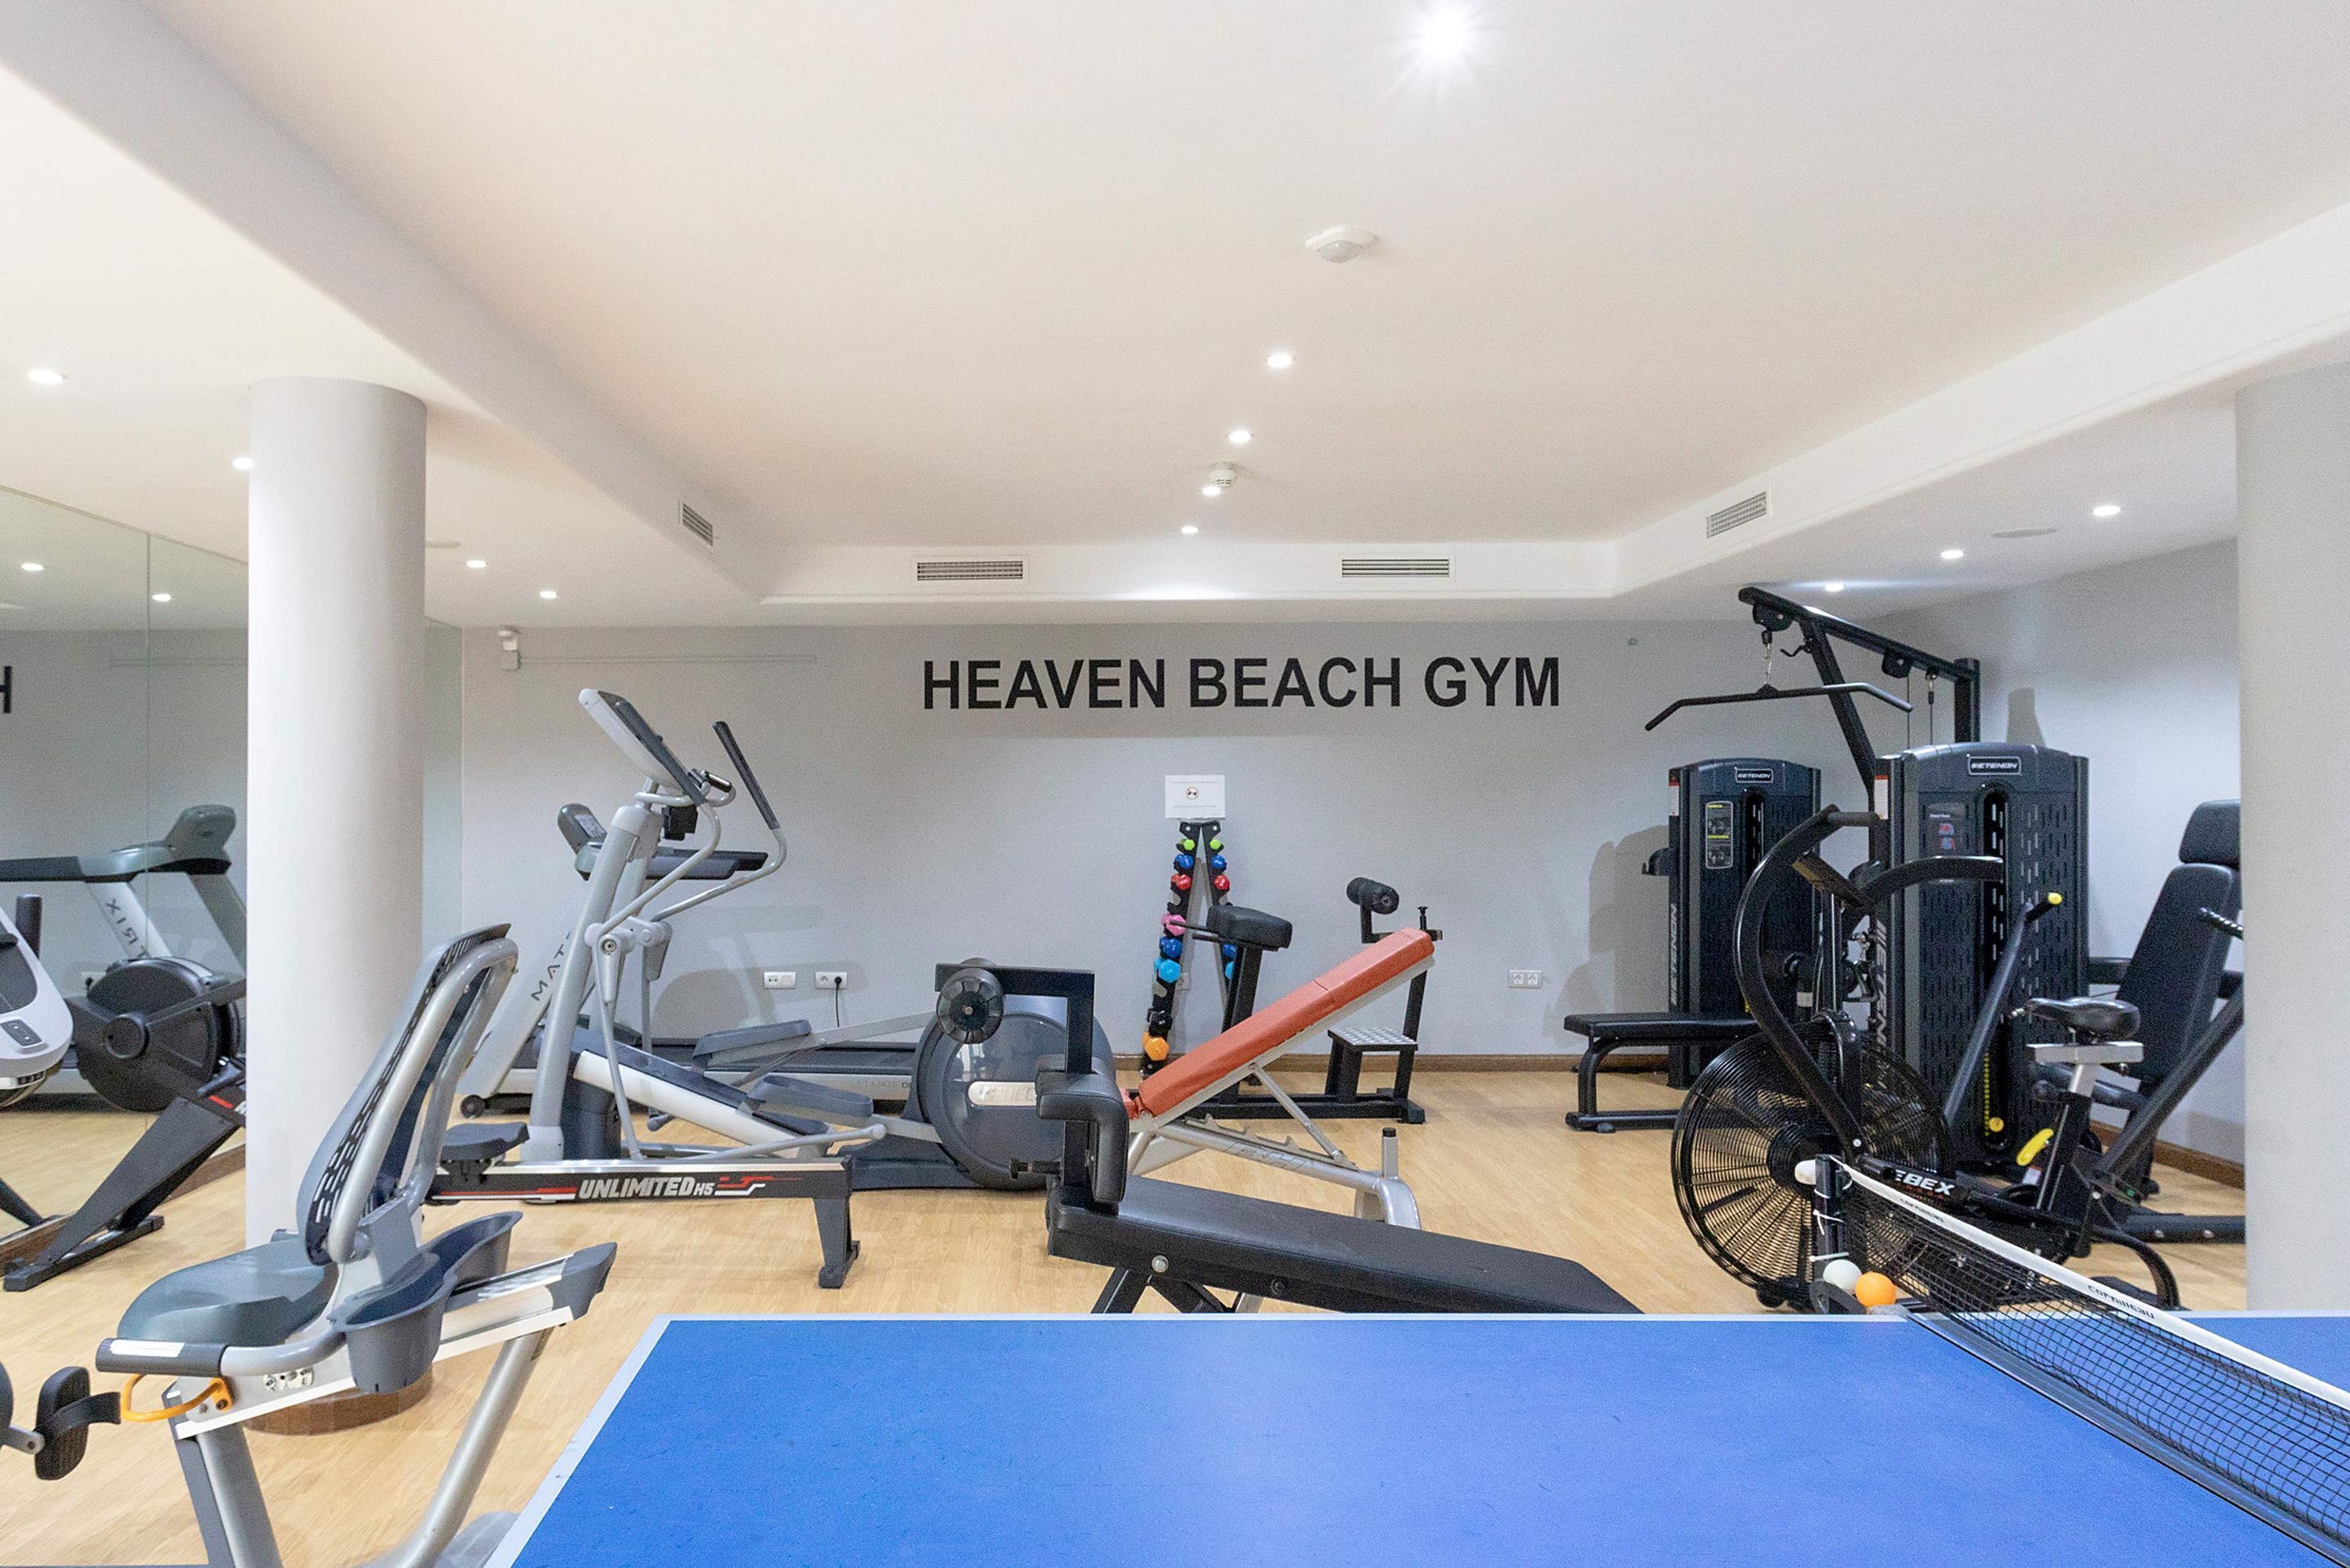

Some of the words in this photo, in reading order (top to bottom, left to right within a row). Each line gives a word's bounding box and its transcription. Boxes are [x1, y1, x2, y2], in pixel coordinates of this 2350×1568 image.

[924, 659, 1164, 709] HEAVEN
[1189, 656, 1401, 708] BEACH
[1424, 656, 1560, 707] GYM
[530, 930, 571, 1002] MAT
[578, 1176, 696, 1200] UNLIMITED
[693, 1182, 715, 1197] H5
